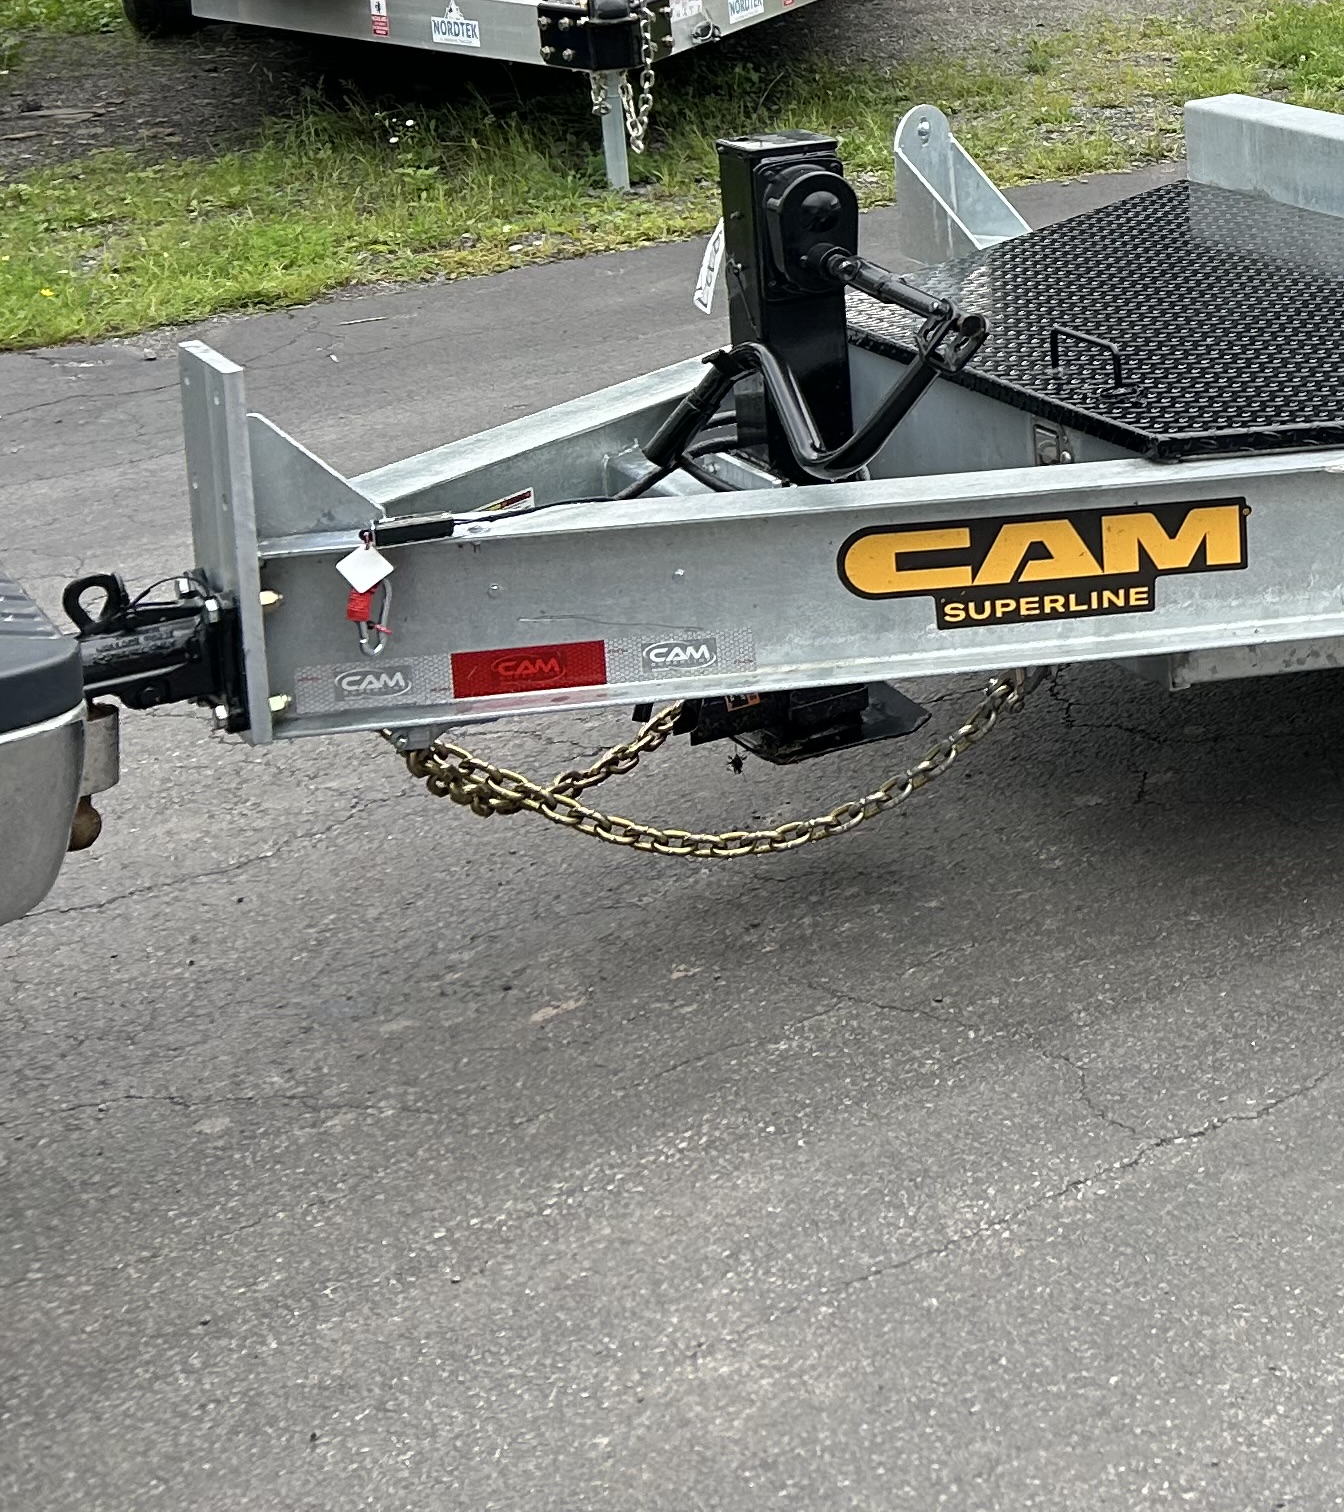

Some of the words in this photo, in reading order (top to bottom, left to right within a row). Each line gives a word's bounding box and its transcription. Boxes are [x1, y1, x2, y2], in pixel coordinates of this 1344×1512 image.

[431, 19, 479, 39] NORDTEK
[844, 503, 1241, 594] CAM
[943, 586, 1149, 623] SUPERLINE
[649, 643, 711, 663] CAM
[498, 656, 560, 676] CAM
[341, 671, 406, 692] CAM
